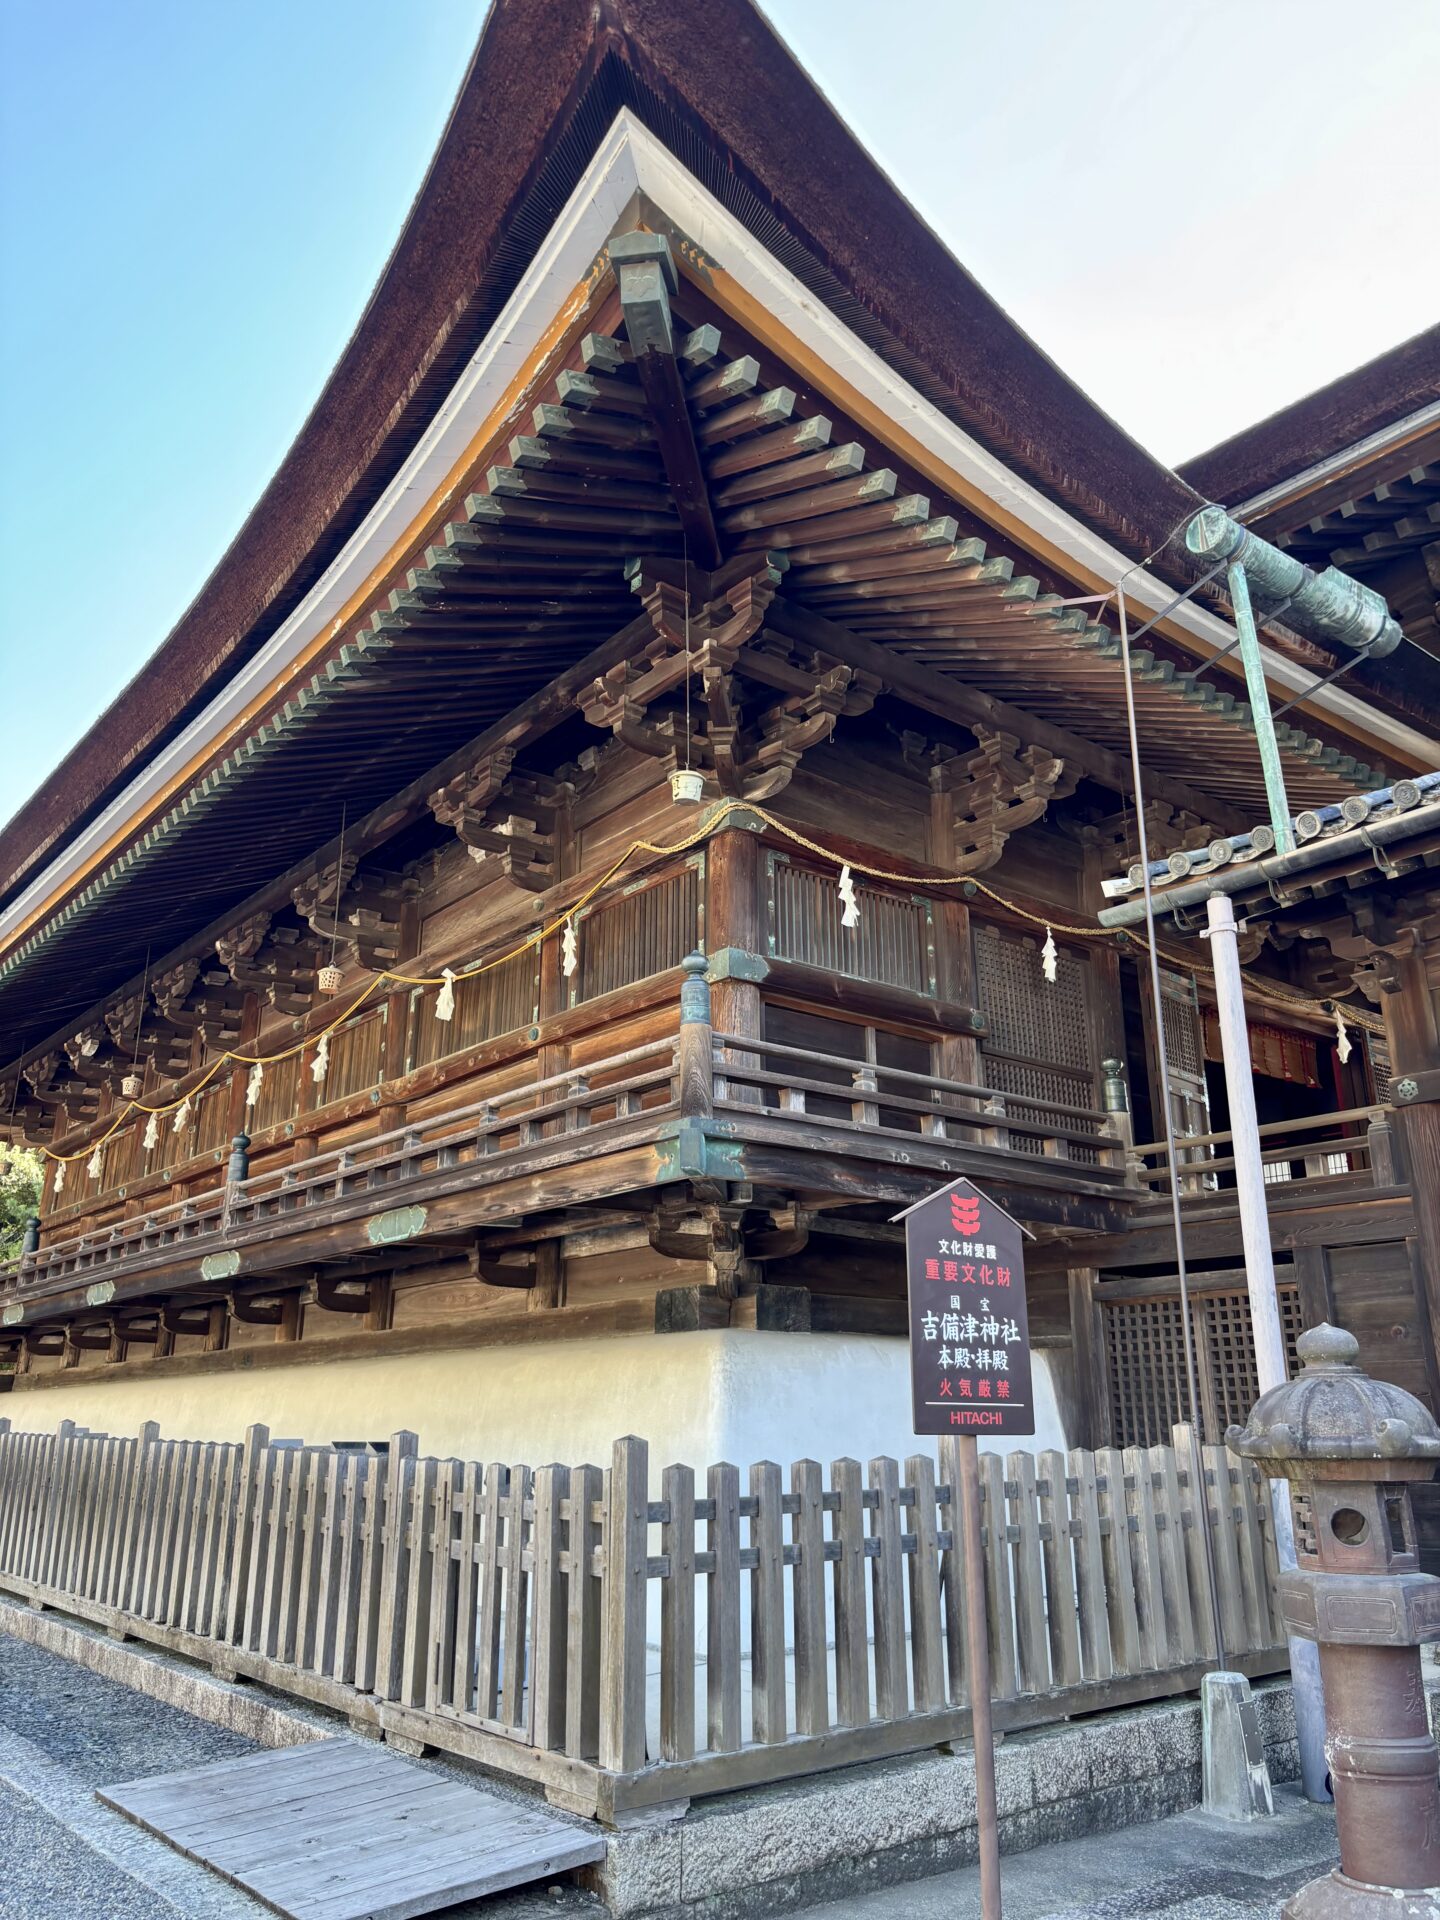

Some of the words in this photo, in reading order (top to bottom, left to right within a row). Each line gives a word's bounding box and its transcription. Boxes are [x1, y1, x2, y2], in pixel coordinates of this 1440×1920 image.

[938, 1239, 997, 1260] 文化財愛護
[925, 1258, 1011, 1287] 重要文化財
[921, 1310, 1021, 1345] 吉備津神社
[939, 1379, 1010, 1398] 火気厳禁
[950, 1411, 1003, 1425] HITACHI
